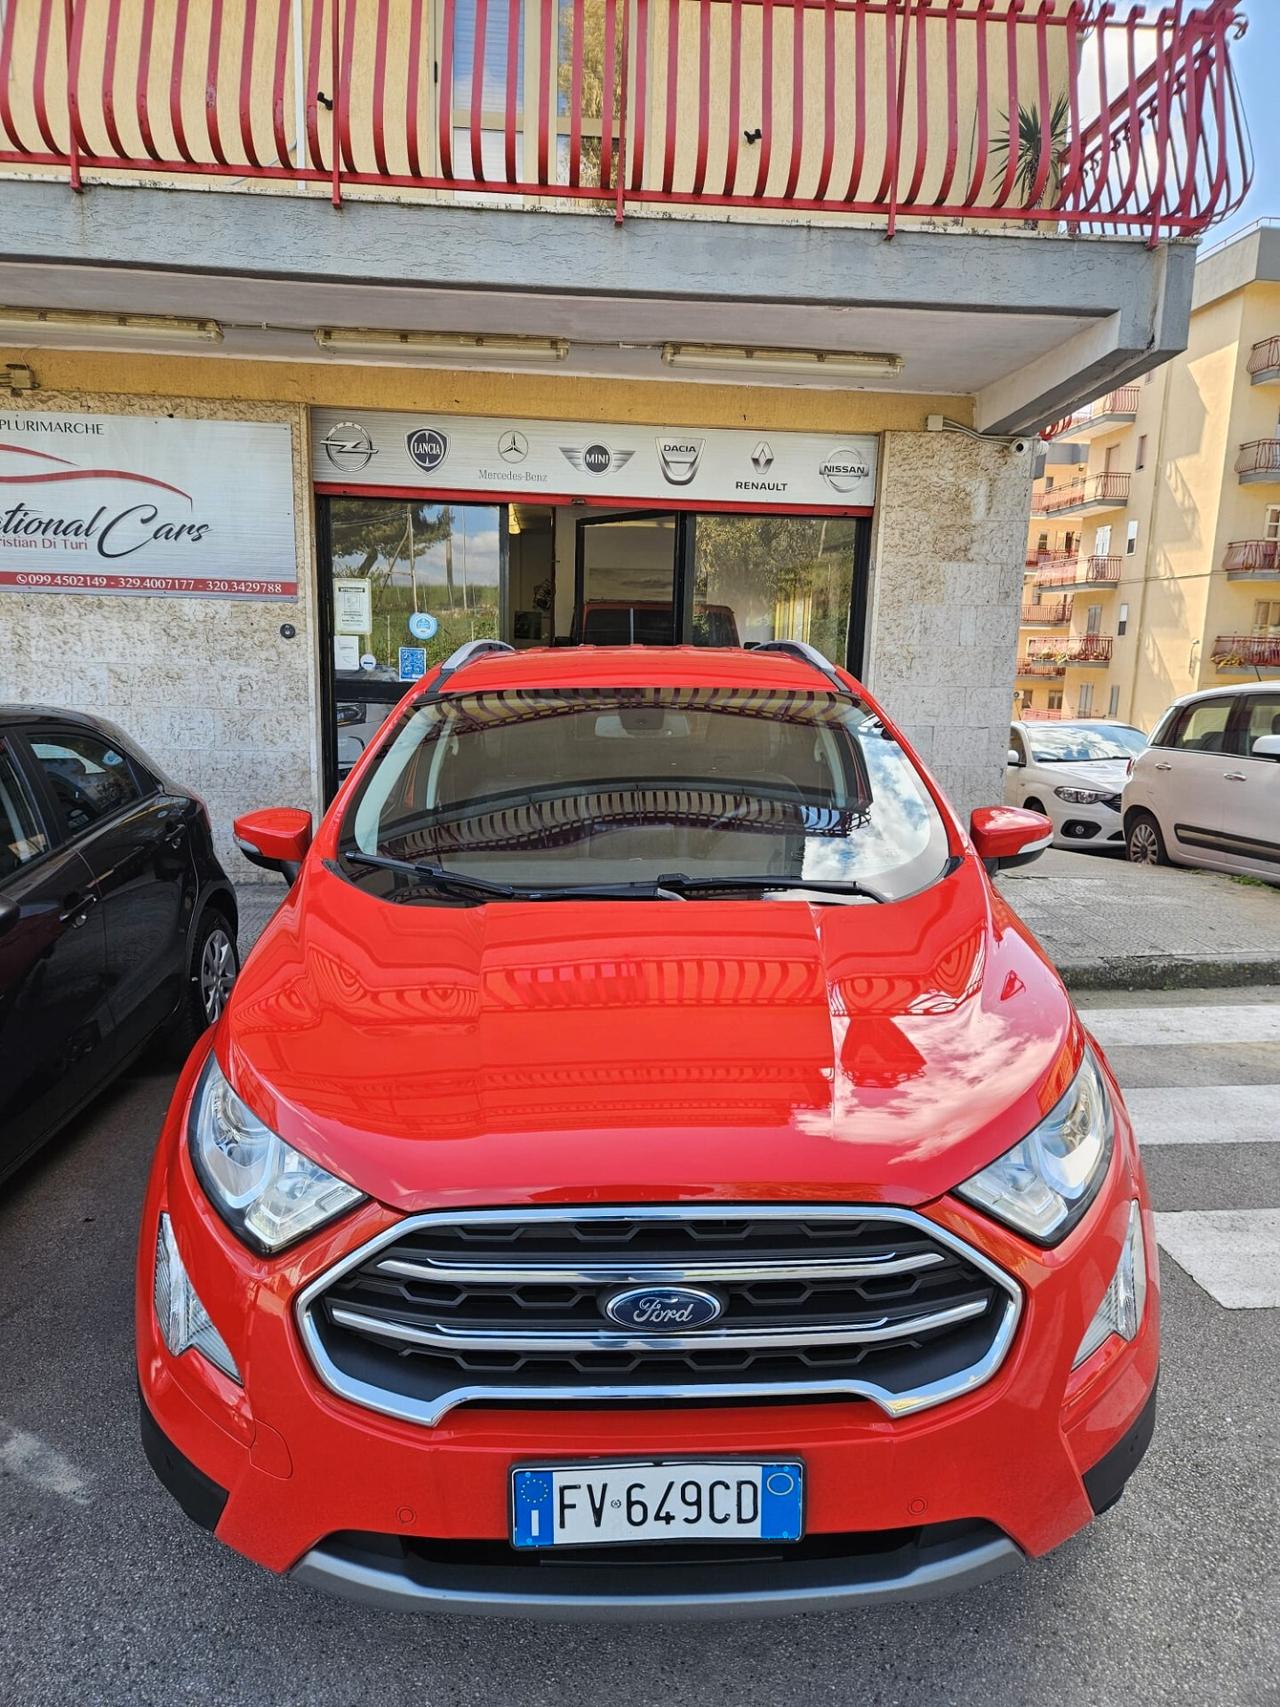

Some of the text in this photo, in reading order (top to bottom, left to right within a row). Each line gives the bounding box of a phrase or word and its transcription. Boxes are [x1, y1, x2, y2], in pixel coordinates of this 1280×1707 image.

[0, 418, 105, 436] PLURIMARCHE
[413, 442, 442, 455] LANCIA
[663, 444, 697, 454] DACIA
[584, 453, 610, 465] MINI
[478, 469, 548, 483] Mercedes-Benz
[823, 464, 866, 475] NISSAN
[735, 481, 788, 492] RENAULT
[97, 504, 213, 558] Cars
[42, 537, 57, 549] Di
[62, 538, 88, 551] Turi
[28, 574, 282, 593] 099.4502149 329.4007177 320.3429788
[633, 1296, 694, 1323] Ford
